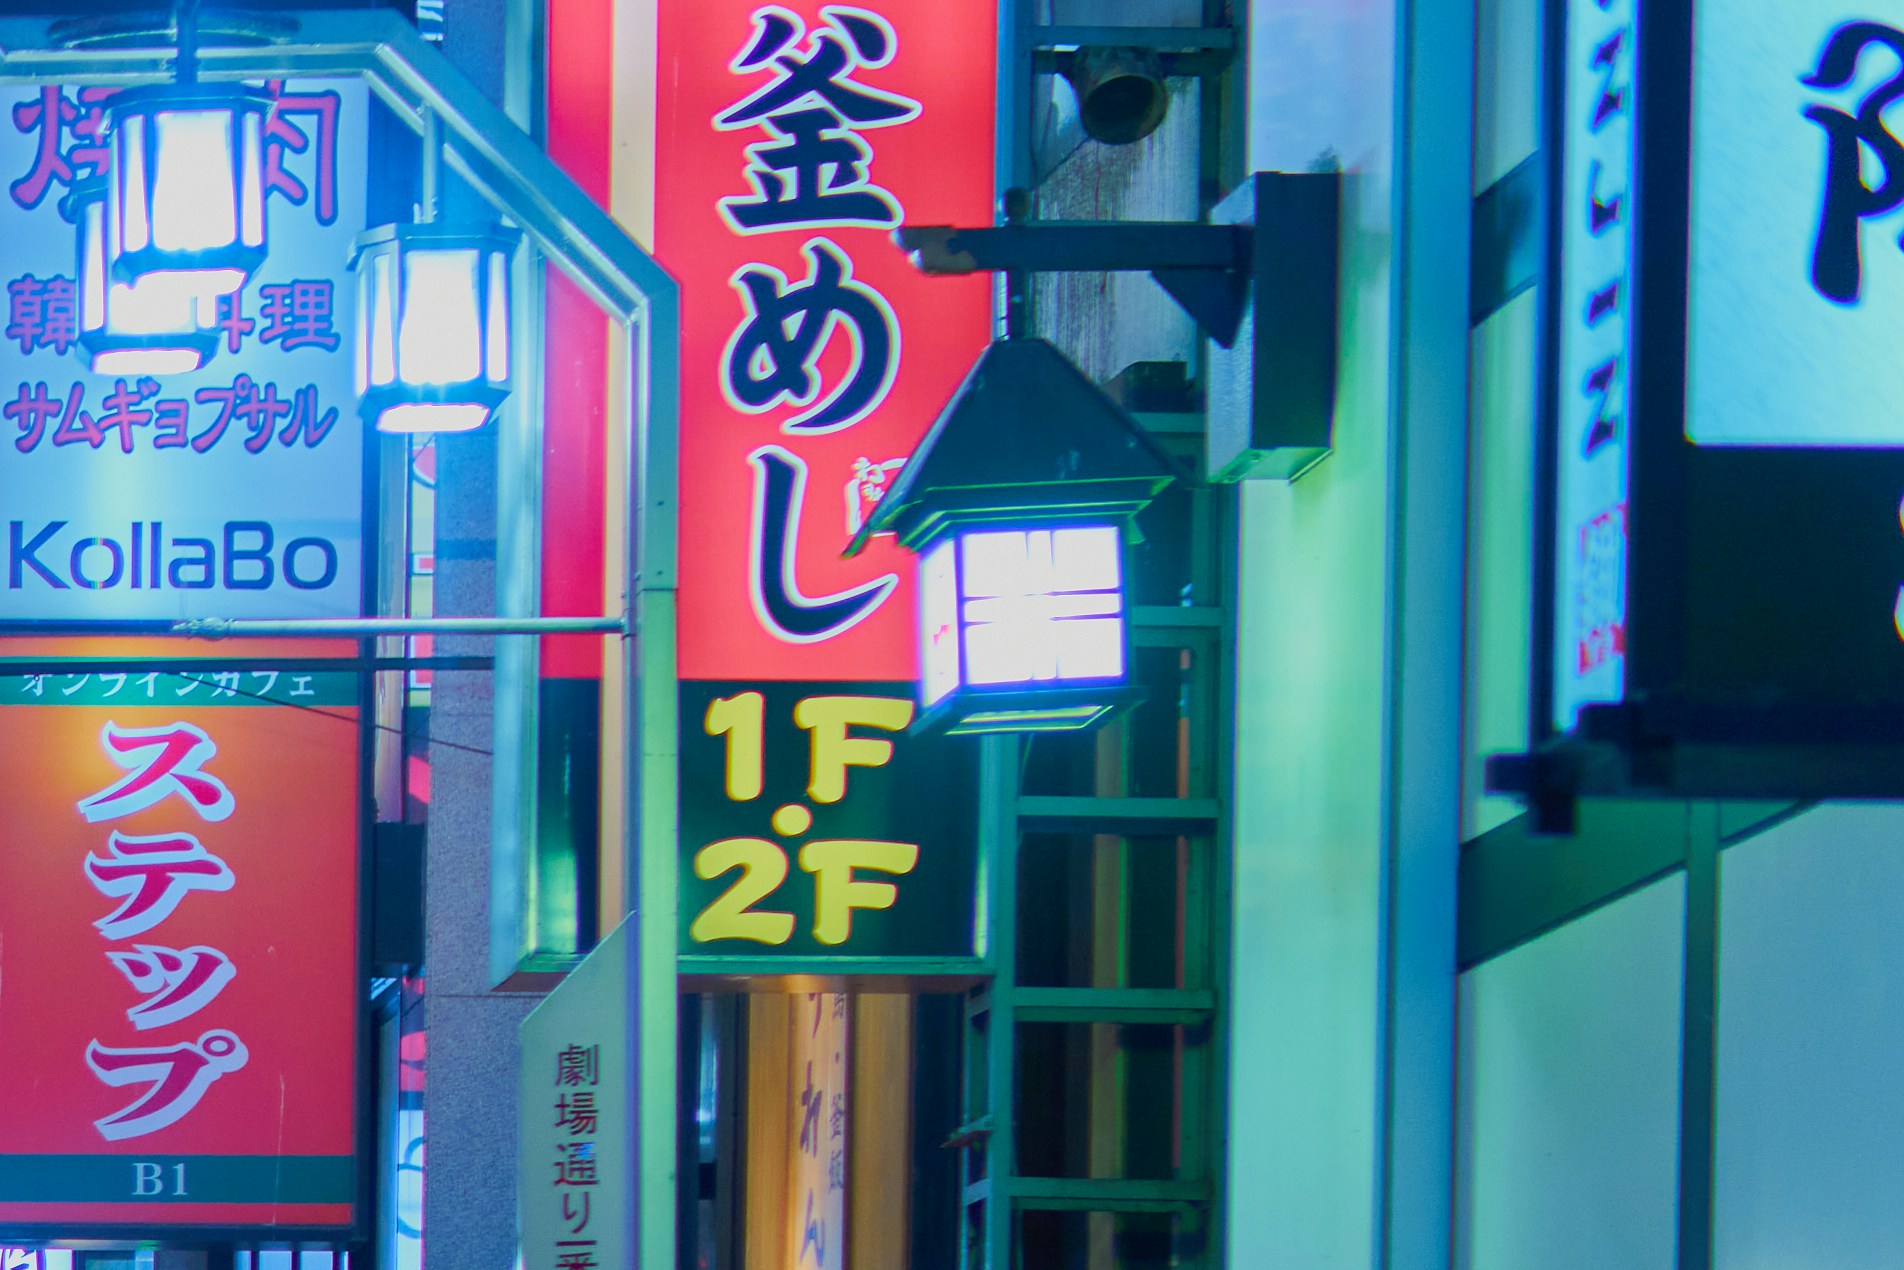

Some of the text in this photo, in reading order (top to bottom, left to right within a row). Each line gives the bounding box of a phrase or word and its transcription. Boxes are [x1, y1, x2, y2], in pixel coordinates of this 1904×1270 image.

[714, 5, 923, 645] 釜めし
[3, 376, 339, 455] サムギョプサル
[8, 519, 339, 592] KollaBo
[704, 690, 916, 804] 1F
[76, 719, 249, 1142] ステップ
[690, 838, 920, 946] 2F
[130, 1162, 190, 1197] B1
